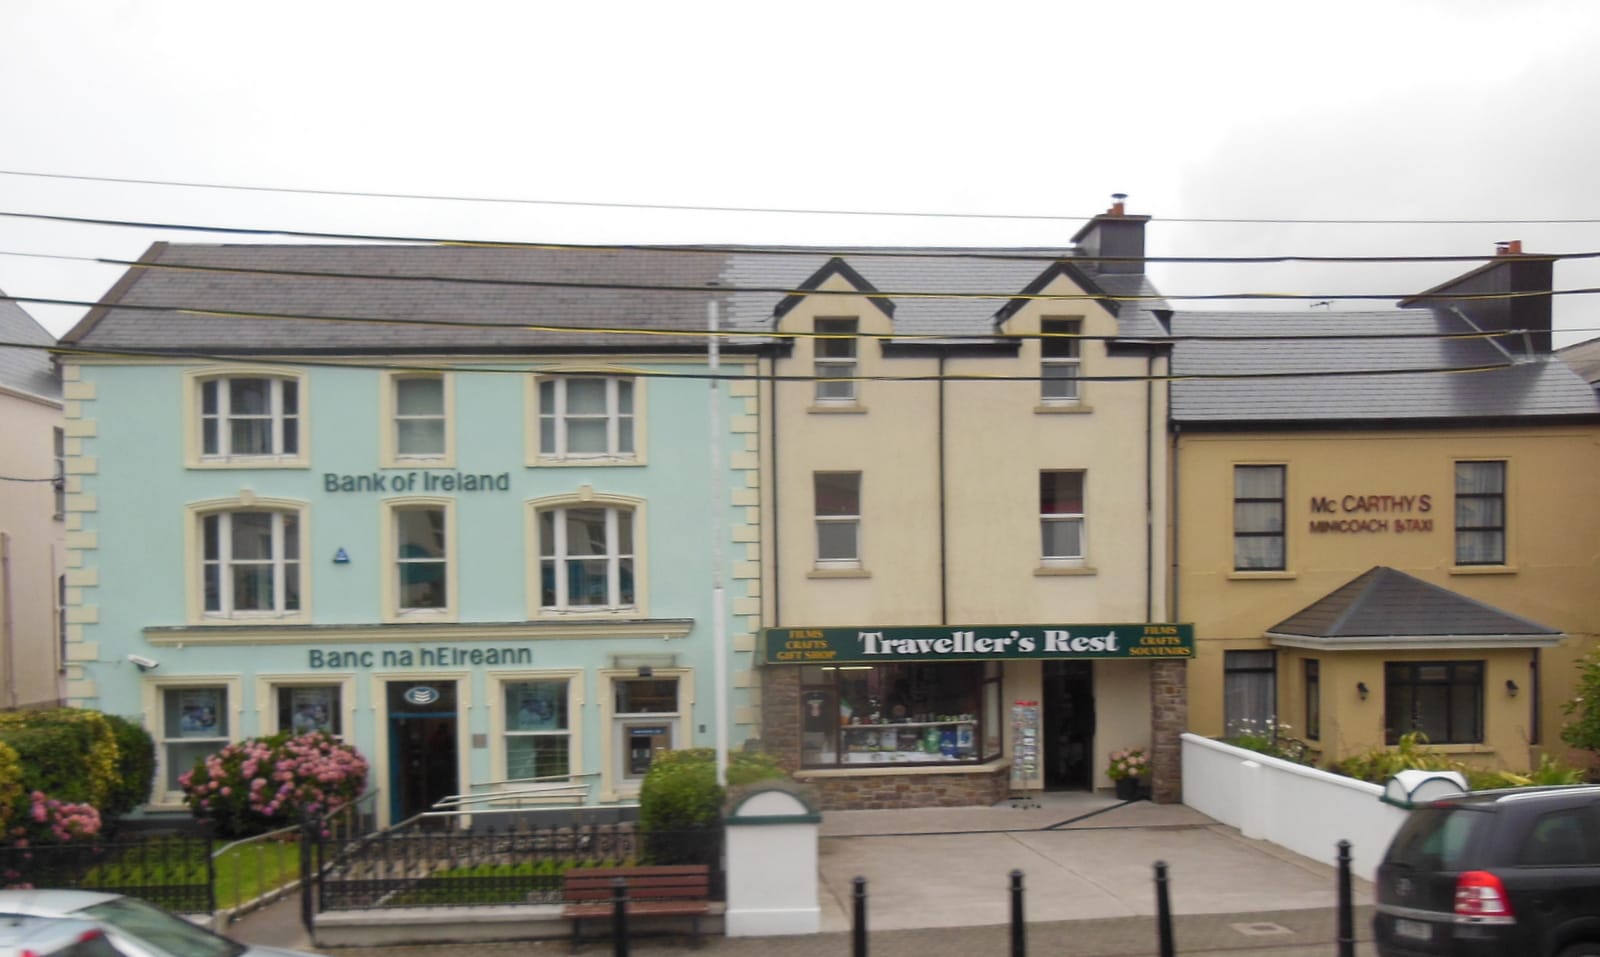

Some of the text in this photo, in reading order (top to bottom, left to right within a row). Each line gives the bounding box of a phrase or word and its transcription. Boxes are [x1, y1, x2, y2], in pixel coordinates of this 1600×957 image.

[323, 471, 511, 493] Bank of Ireland
[1310, 496, 1337, 513] Mc
[785, 640, 828, 649] CRAFTS
[858, 629, 1120, 655] Traveller's Rest
[1140, 636, 1180, 645] CRAFTS
[309, 649, 373, 669] Banc
[382, 649, 414, 667] na
[776, 651, 802, 660] GIFT
